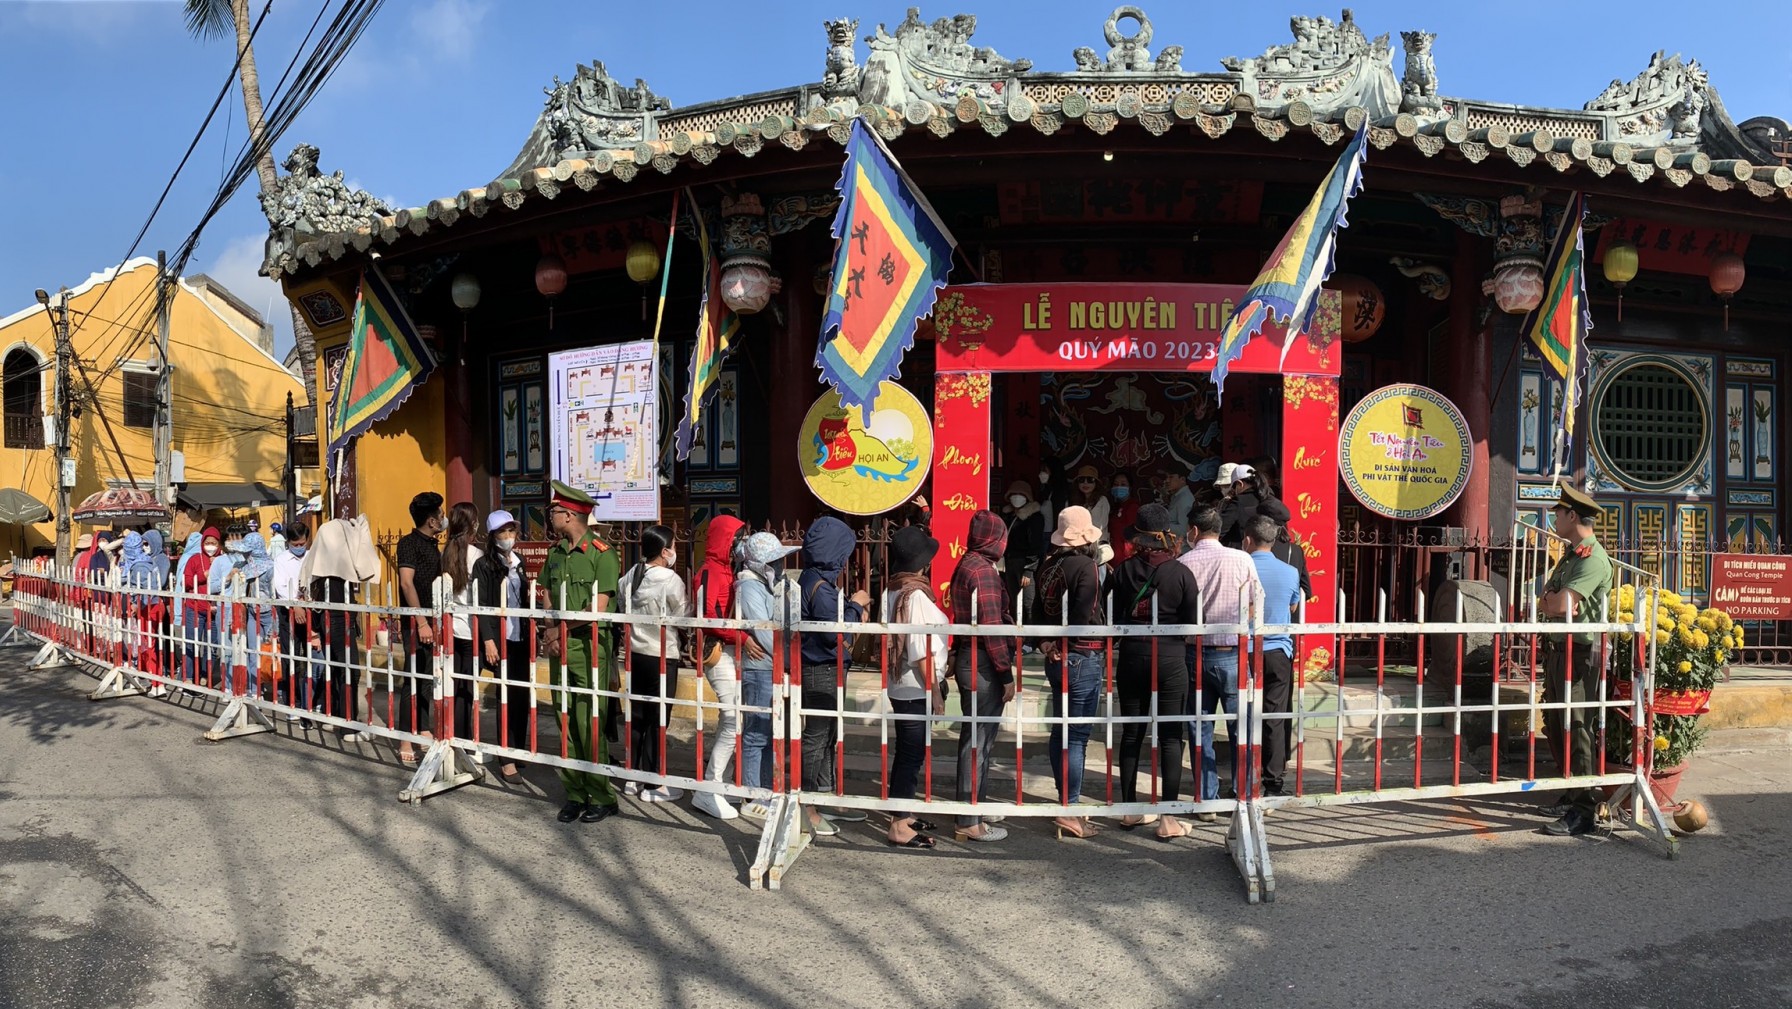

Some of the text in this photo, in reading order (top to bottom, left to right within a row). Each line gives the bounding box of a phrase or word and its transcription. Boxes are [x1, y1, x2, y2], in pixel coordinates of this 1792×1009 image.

[1023, 292, 1233, 330] LỄ NGUYÊN TIÊ
[1058, 337, 1214, 360] QUÝ MÃO 2023
[876, 453, 889, 462] AN
[938, 446, 983, 476] Phong
[1294, 446, 1326, 470] Quốc
[1412, 448, 1427, 460] An
[1410, 474, 1432, 484] QUỐC
[943, 493, 977, 511] Điều
[1298, 493, 1321, 519] Thái
[1724, 561, 1730, 569] DI
[1731, 560, 1742, 569] TÍCH
[1757, 562, 1771, 570] QUAN
[1772, 561, 1786, 571] CÔNG
[1726, 570, 1743, 578] Quan
[1744, 571, 1760, 579] Cong
[1726, 606, 1780, 615] NO PARKING
